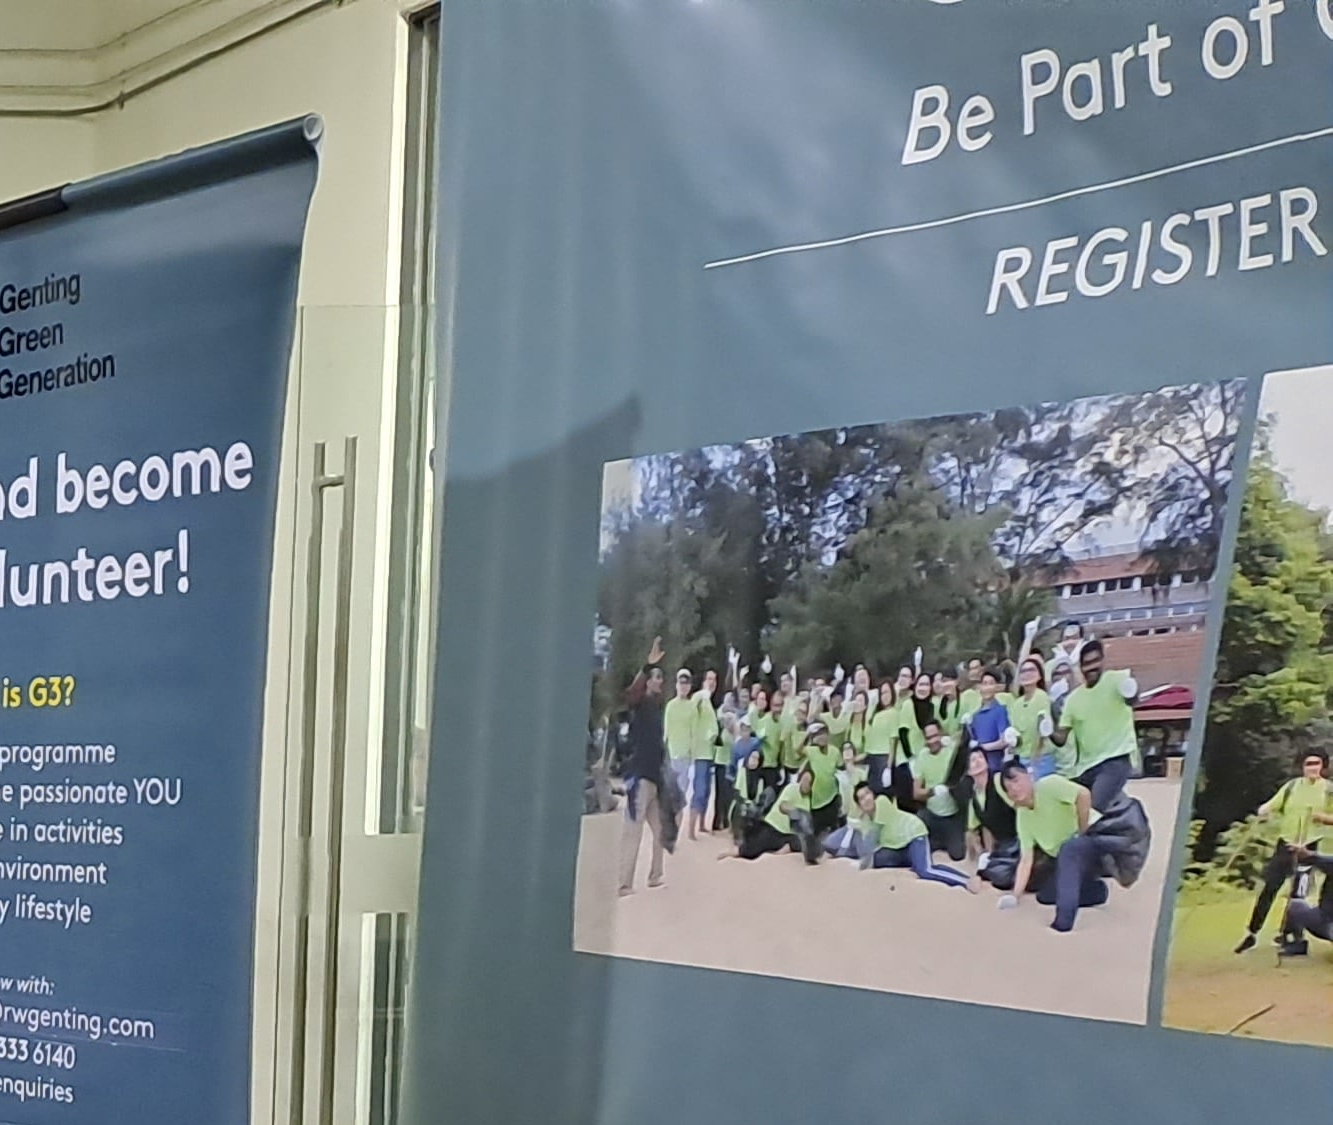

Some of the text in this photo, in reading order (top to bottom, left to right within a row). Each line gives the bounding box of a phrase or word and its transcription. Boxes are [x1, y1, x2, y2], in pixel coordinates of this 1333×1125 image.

[900, 84, 995, 166] Be
[1020, 22, 1173, 136] Part
[1200, 0, 1285, 80] of
[984, 186, 1328, 315] REGISTER
[0, 272, 81, 314] Genting
[55, 440, 255, 514] become
[2, 677, 21, 708] is
[28, 675, 77, 708] G3?
[19, 778, 128, 810] passionate
[132, 778, 182, 806] YOU
[10, 817, 29, 842] in
[34, 819, 124, 845] activities
[15, 894, 93, 929] lifestyle
[16, 975, 55, 997] with:
[32, 1040, 76, 1070] 6140
